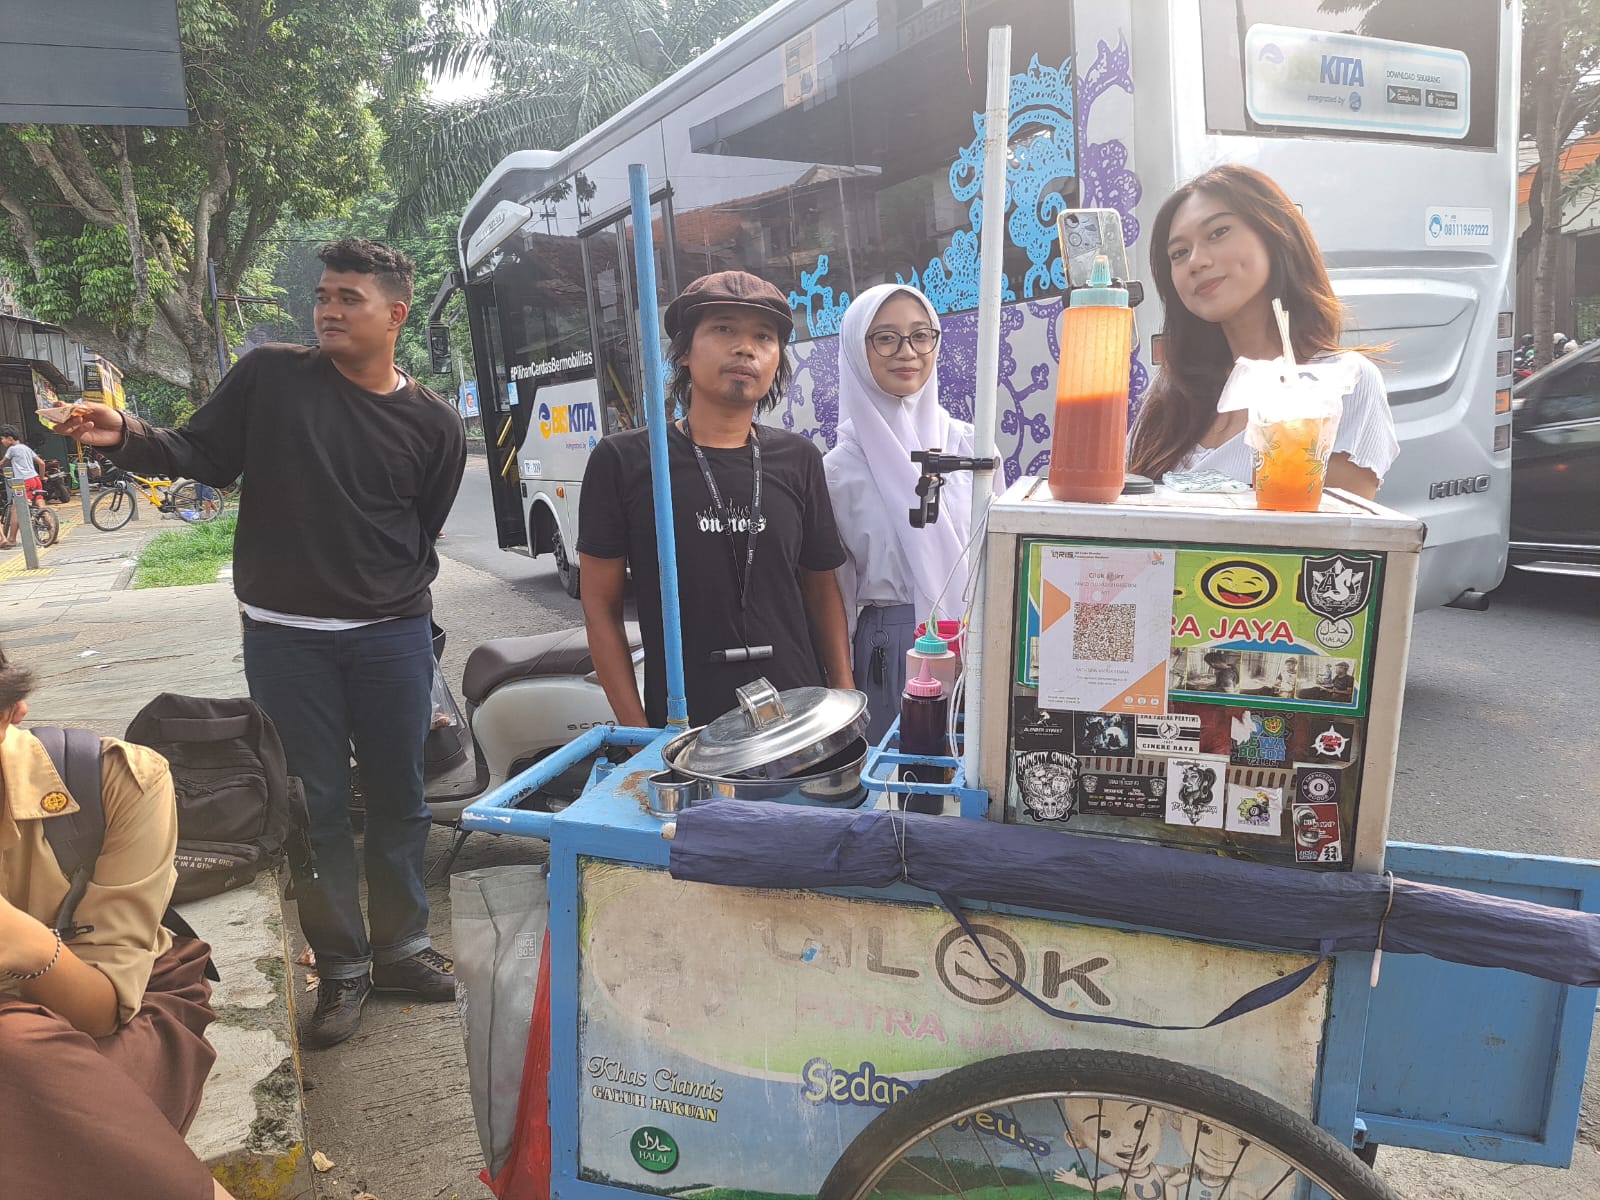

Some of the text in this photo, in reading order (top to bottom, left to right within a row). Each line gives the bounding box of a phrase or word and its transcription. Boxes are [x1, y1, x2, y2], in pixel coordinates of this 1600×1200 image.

[1429, 474, 1491, 500] HINO
[1210, 618, 1294, 643] JAYA
[1322, 636, 1345, 644] HALAL
[587, 1055, 724, 1102] Khas Ciamis
[591, 1085, 719, 1122] GALUH PAKUAN
[639, 1151, 668, 1164] HALAL
